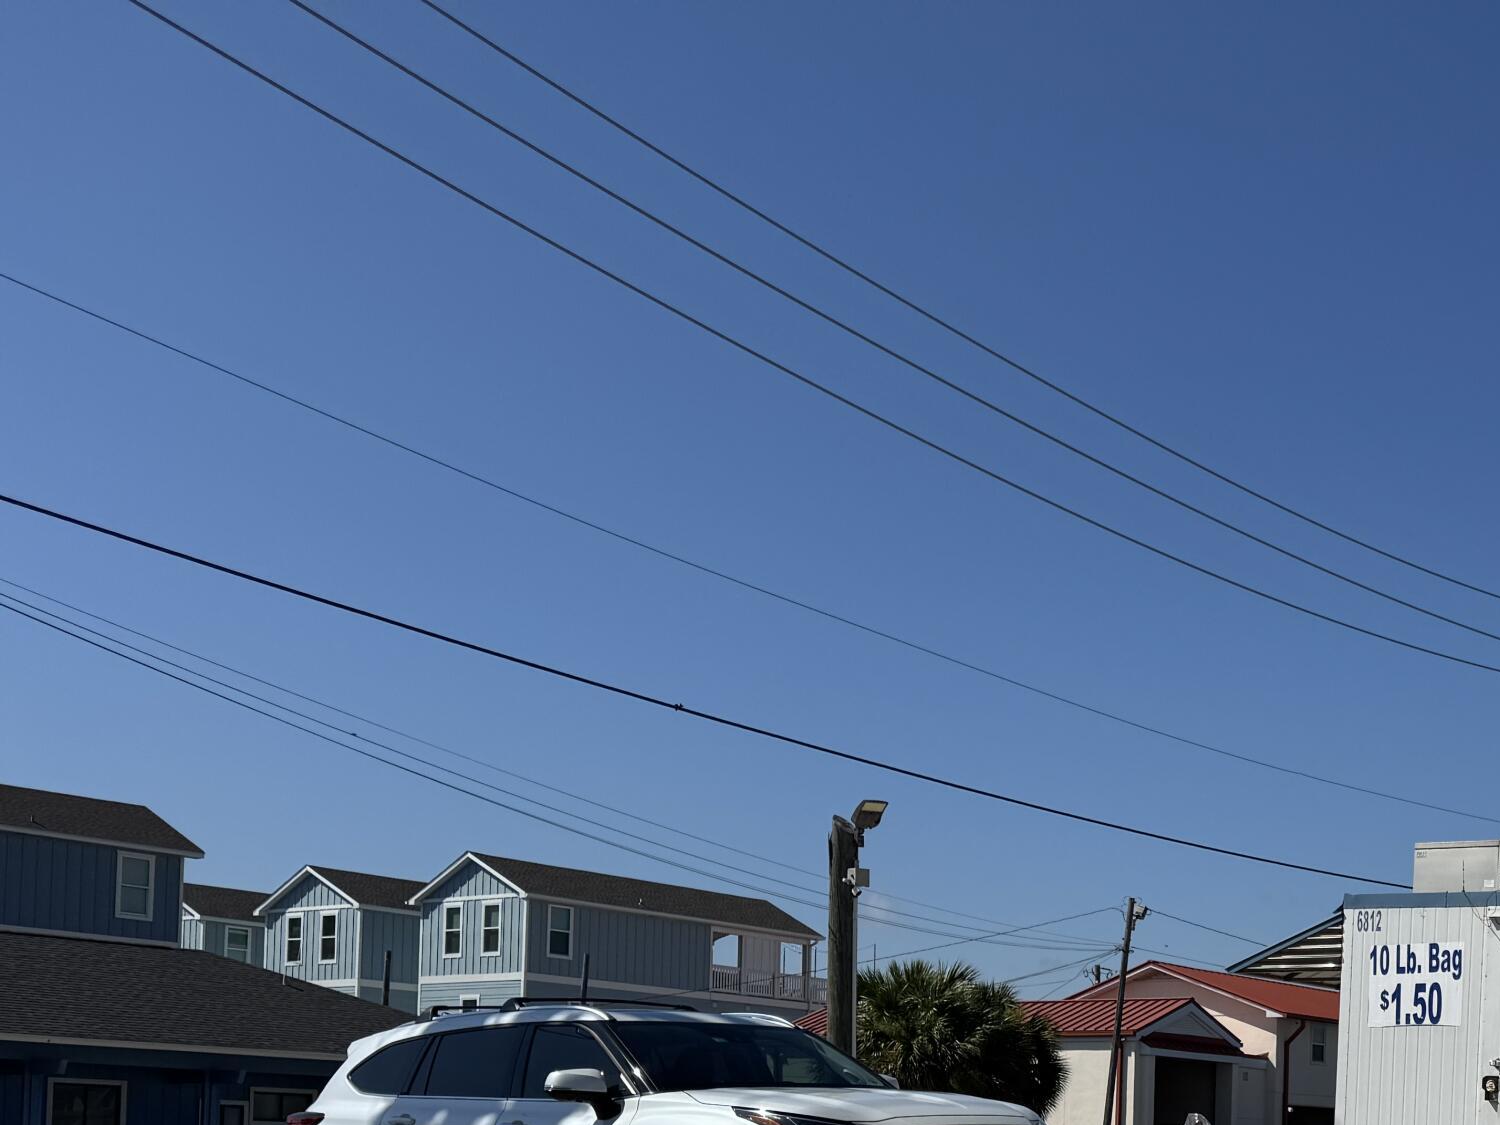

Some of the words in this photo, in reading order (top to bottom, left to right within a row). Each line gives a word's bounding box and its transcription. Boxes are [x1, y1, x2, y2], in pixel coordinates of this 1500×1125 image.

[1356, 910, 1383, 933] 6812
[1369, 945, 1390, 976] 10
[1396, 944, 1422, 974] Lb.
[1428, 942, 1463, 981] Bag
[1379, 982, 1443, 1025] $1.50
